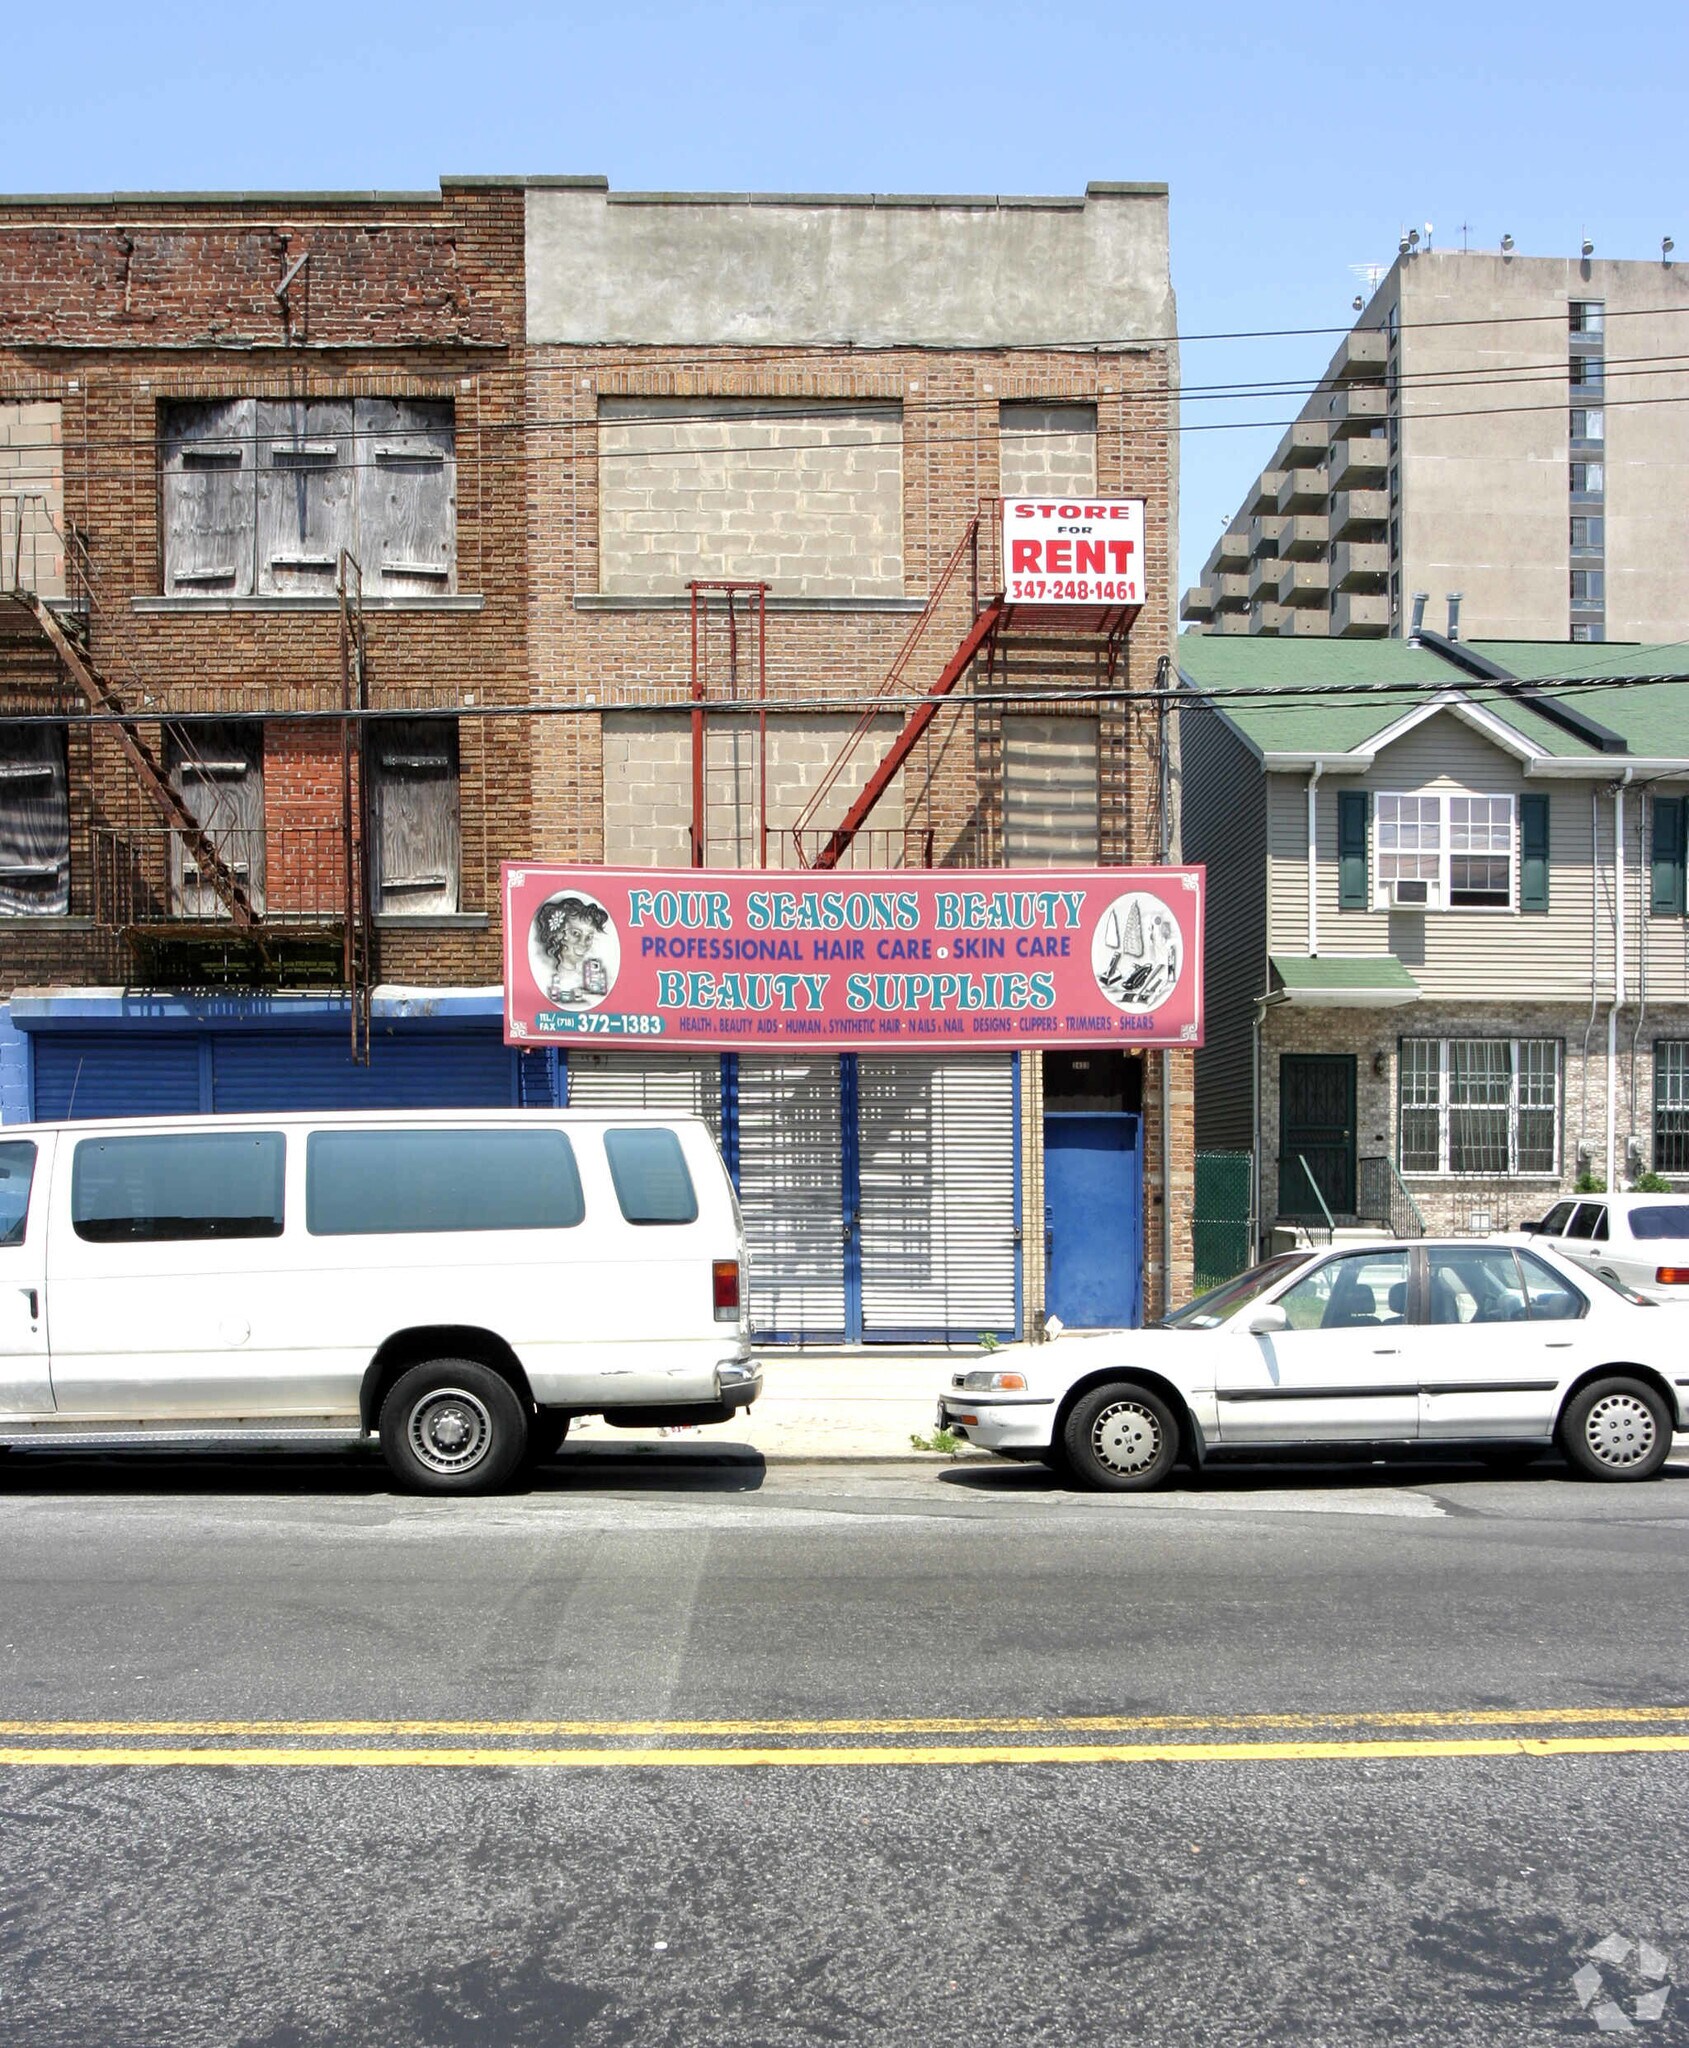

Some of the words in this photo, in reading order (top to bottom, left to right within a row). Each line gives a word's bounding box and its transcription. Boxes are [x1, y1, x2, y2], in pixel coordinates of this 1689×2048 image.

[1015, 504, 1130, 520] STORE
[1057, 526, 1093, 534] FOR
[1012, 539, 1134, 575] RENT
[628, 889, 733, 930] FOUR
[746, 890, 920, 930] SEASONS
[935, 890, 1087, 930] BEAUTY
[642, 936, 803, 960] PROFESSIONAL
[813, 938, 865, 960] HAIR
[877, 938, 932, 960] CARE
[953, 937, 1006, 958] SKIN
[1016, 935, 1071, 957] CARE
[657, 970, 830, 1011] BEAUTY
[846, 971, 1056, 1011] SUPPLIES
[539, 1023, 556, 1031] FAX
[557, 1018, 575, 1027] (718)
[577, 1013, 661, 1034] 372-1383
[679, 1017, 711, 1032] HEALTH
[719, 1018, 752, 1033] BEAUTY
[757, 1018, 778, 1033] AIDS
[785, 1019, 821, 1034] HUMAN
[829, 1018, 875, 1033] SYNTHETIC
[879, 1018, 901, 1033] HAIR
[943, 1018, 964, 1032] NAIL
[973, 1017, 1011, 1032] DESIGNS
[1019, 1016, 1057, 1031] CLIPPERS
[1065, 1016, 1112, 1031] TRIMMERS
[1119, 1016, 1154, 1030] SHEARS
